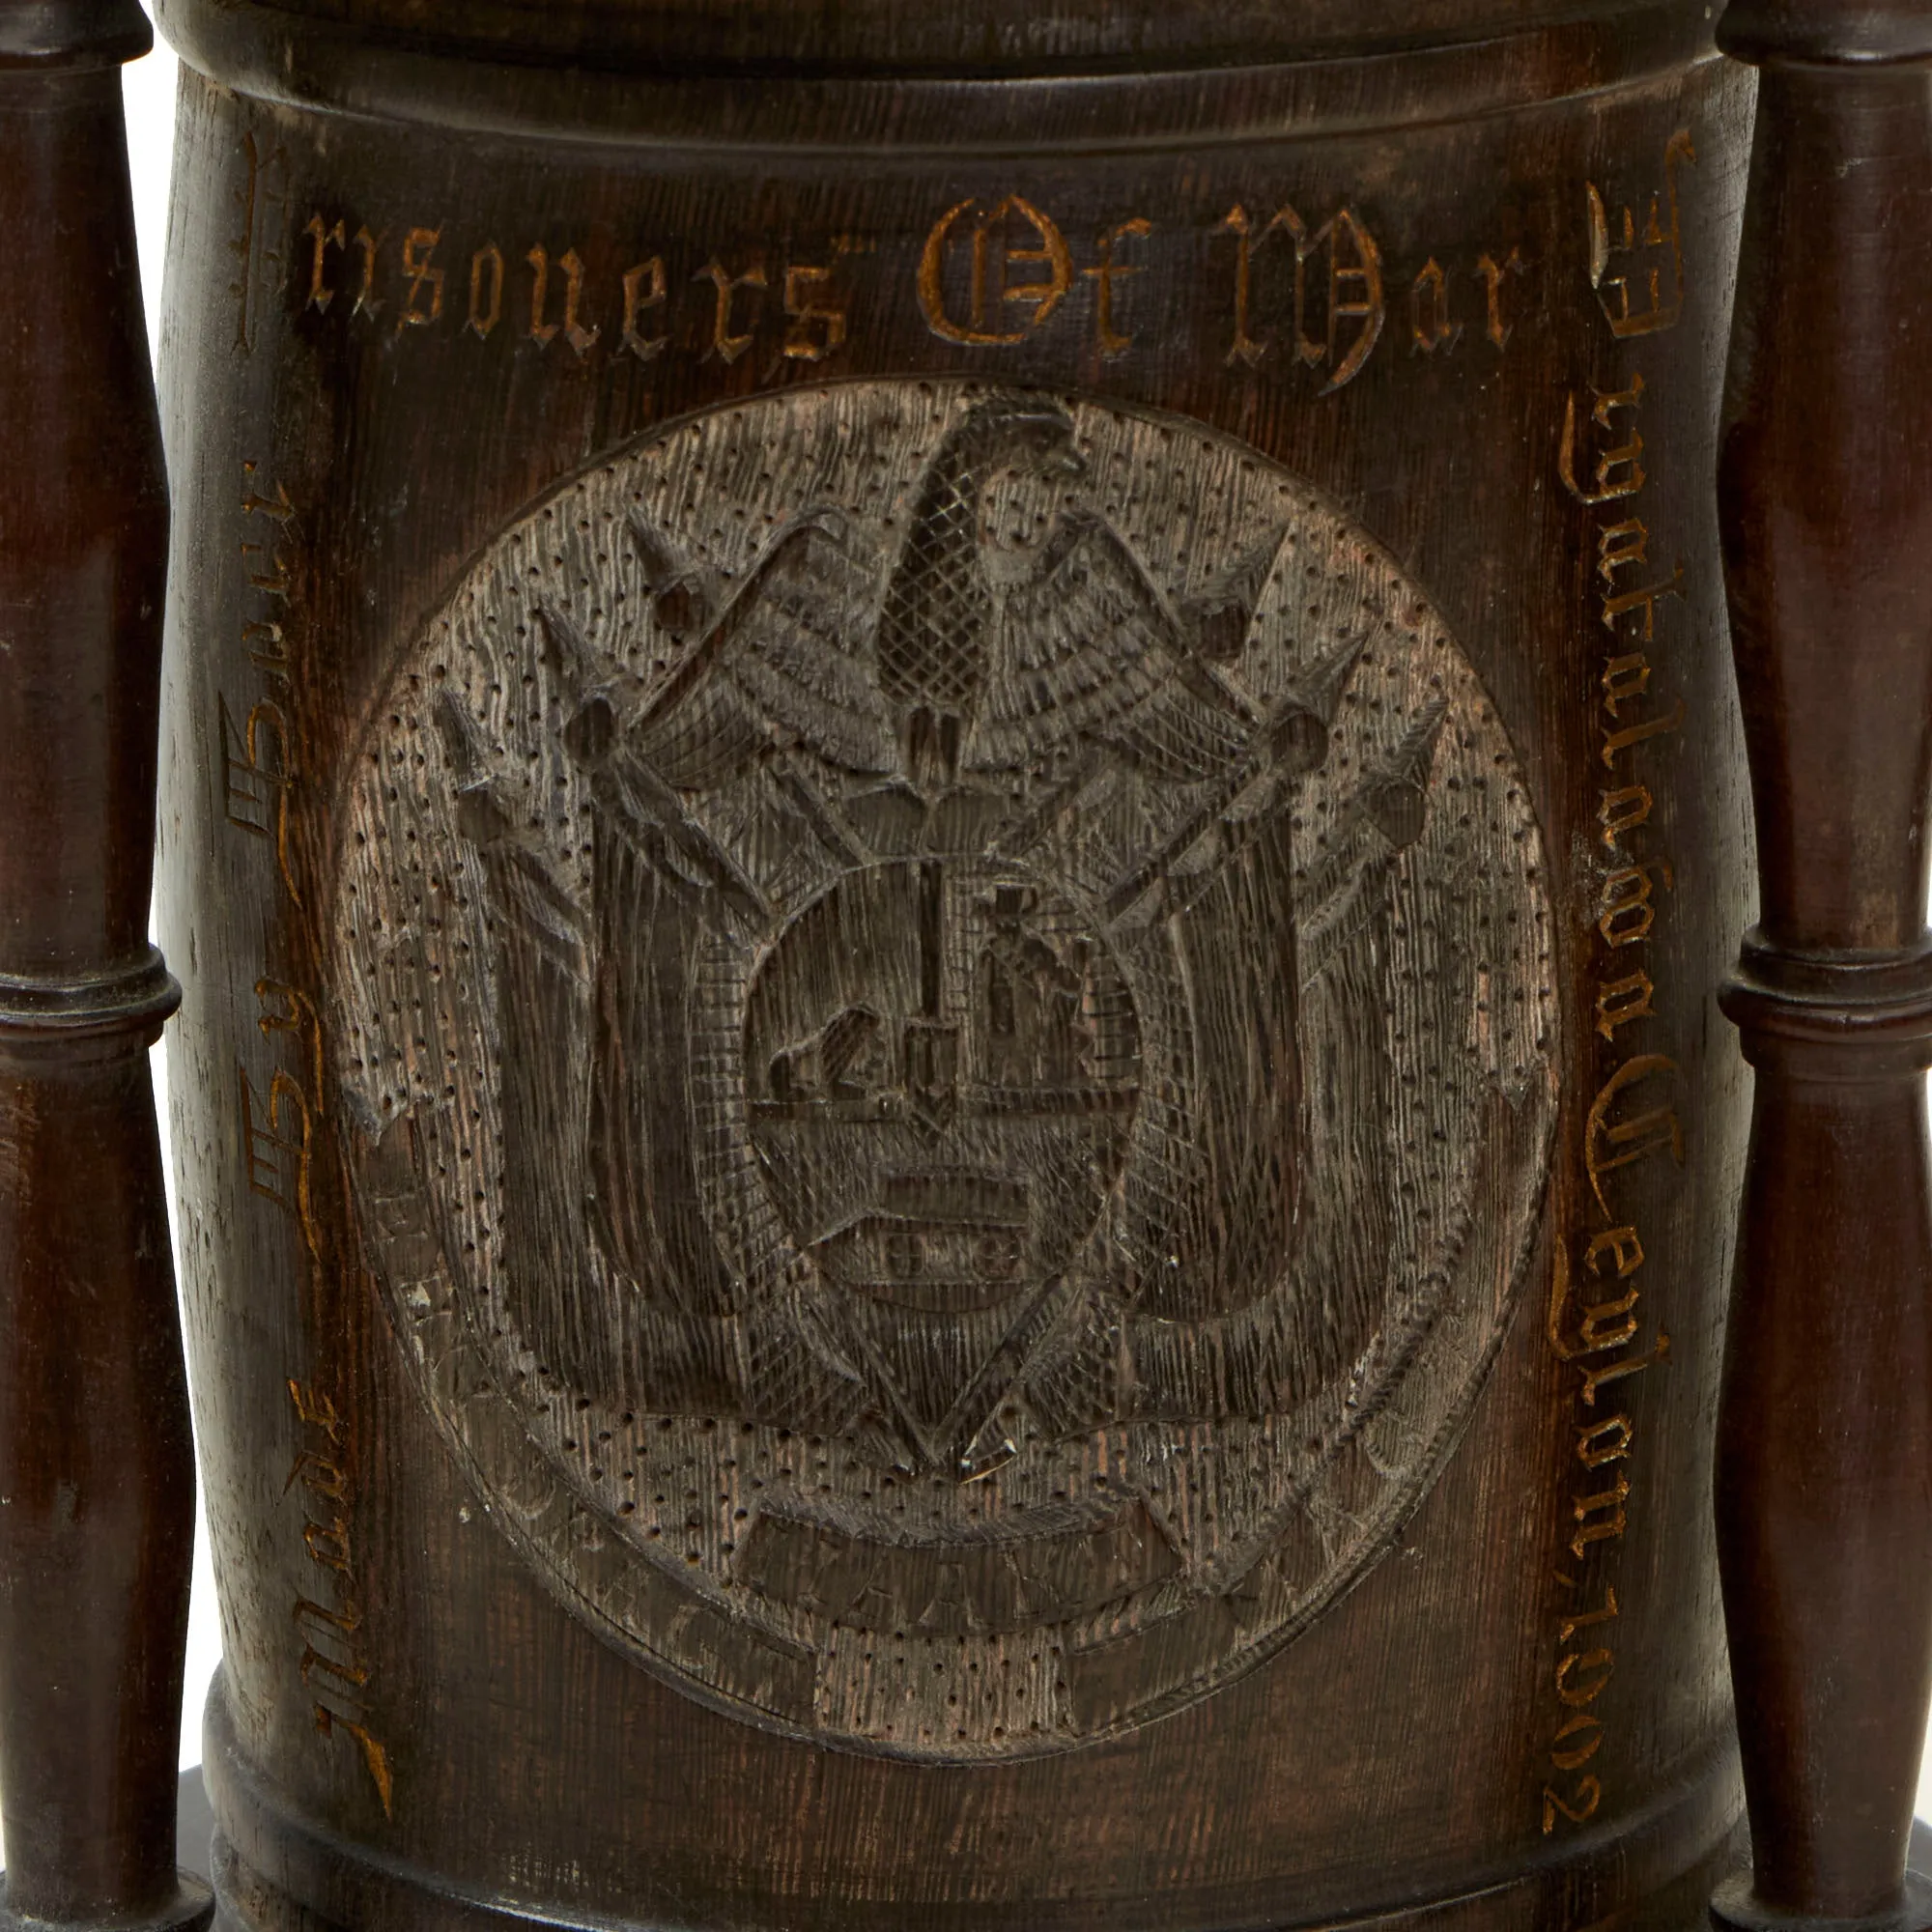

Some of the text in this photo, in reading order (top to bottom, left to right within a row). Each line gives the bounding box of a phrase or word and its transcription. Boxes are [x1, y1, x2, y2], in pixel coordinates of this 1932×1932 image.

[914, 195, 1155, 367] Of
[239, 977, 324, 1263] By
[275, 1378, 394, 1823] Made
[1541, 1582, 1620, 1836] 1902
